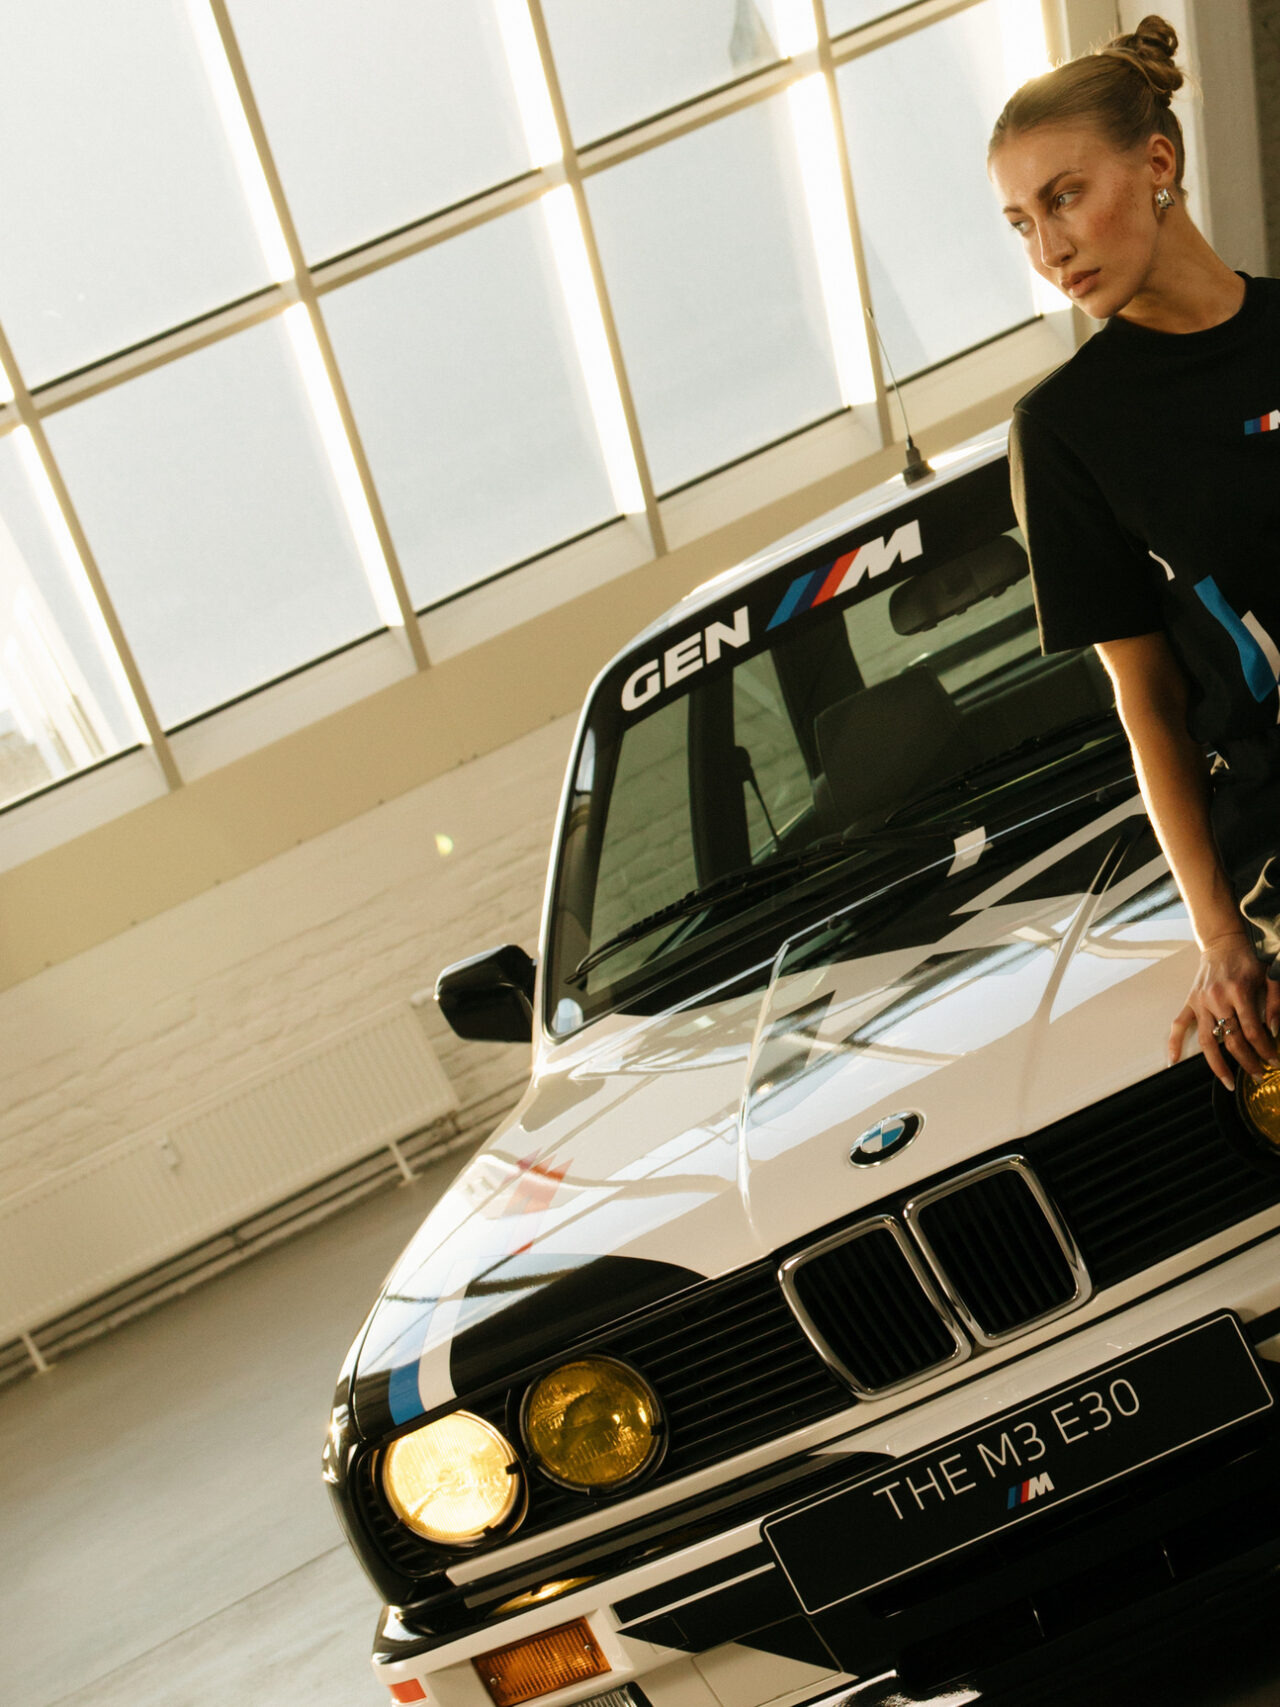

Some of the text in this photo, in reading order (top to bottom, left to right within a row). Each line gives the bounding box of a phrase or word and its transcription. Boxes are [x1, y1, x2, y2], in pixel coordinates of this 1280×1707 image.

[620, 518, 924, 713] GEN M
[872, 1378, 1140, 1520] THE M3 E30
[1028, 1471, 1055, 1500] M
